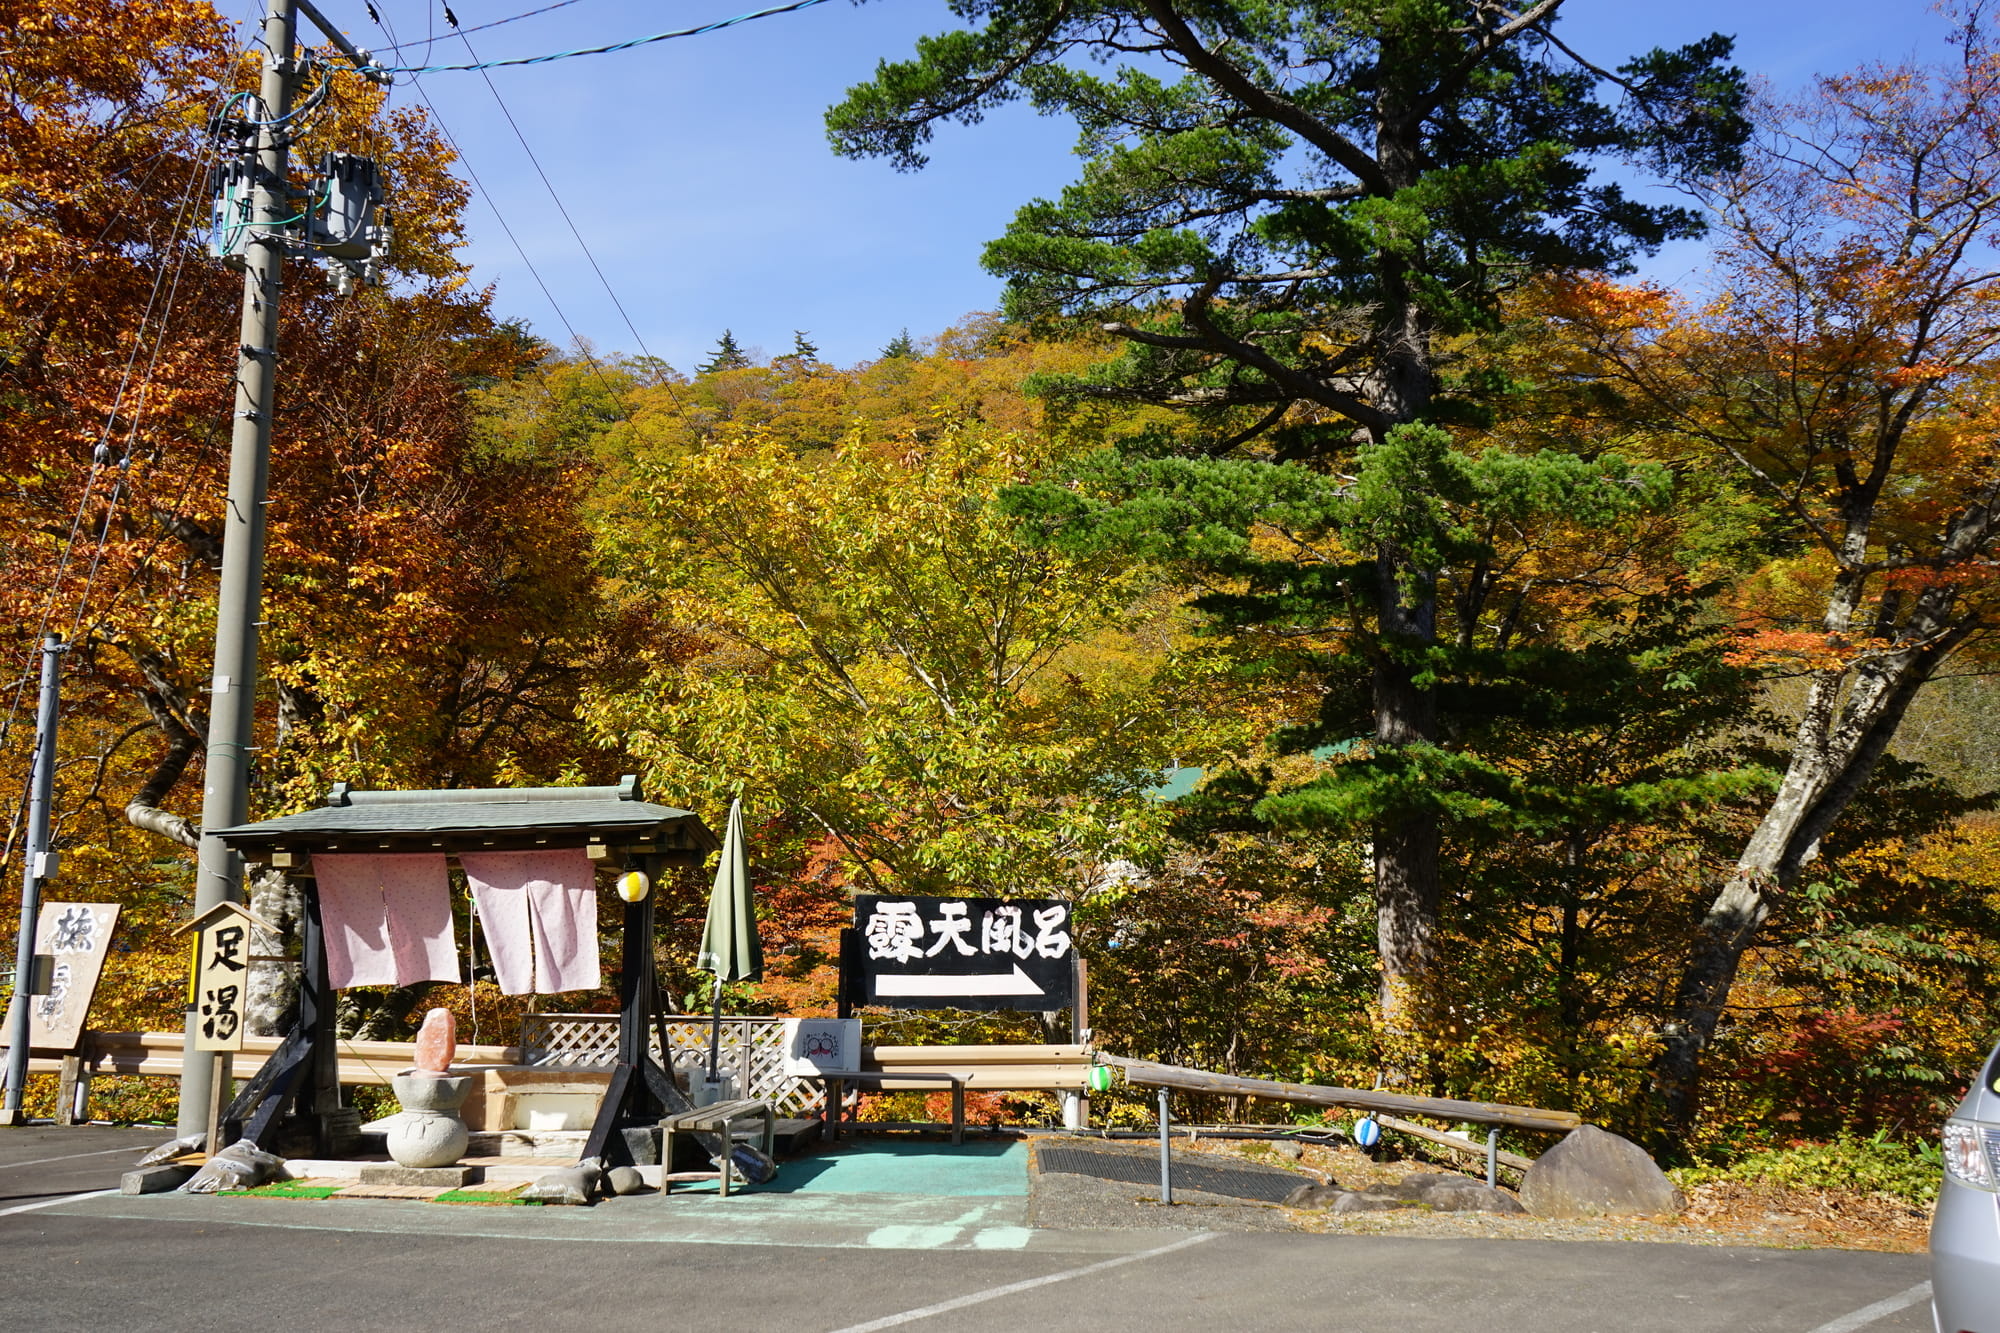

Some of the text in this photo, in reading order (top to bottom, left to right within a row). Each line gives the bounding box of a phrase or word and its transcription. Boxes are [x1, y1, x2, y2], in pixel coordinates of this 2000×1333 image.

[865, 901, 1071, 963] 露天風呂
[202, 925, 247, 1040] 足湯
